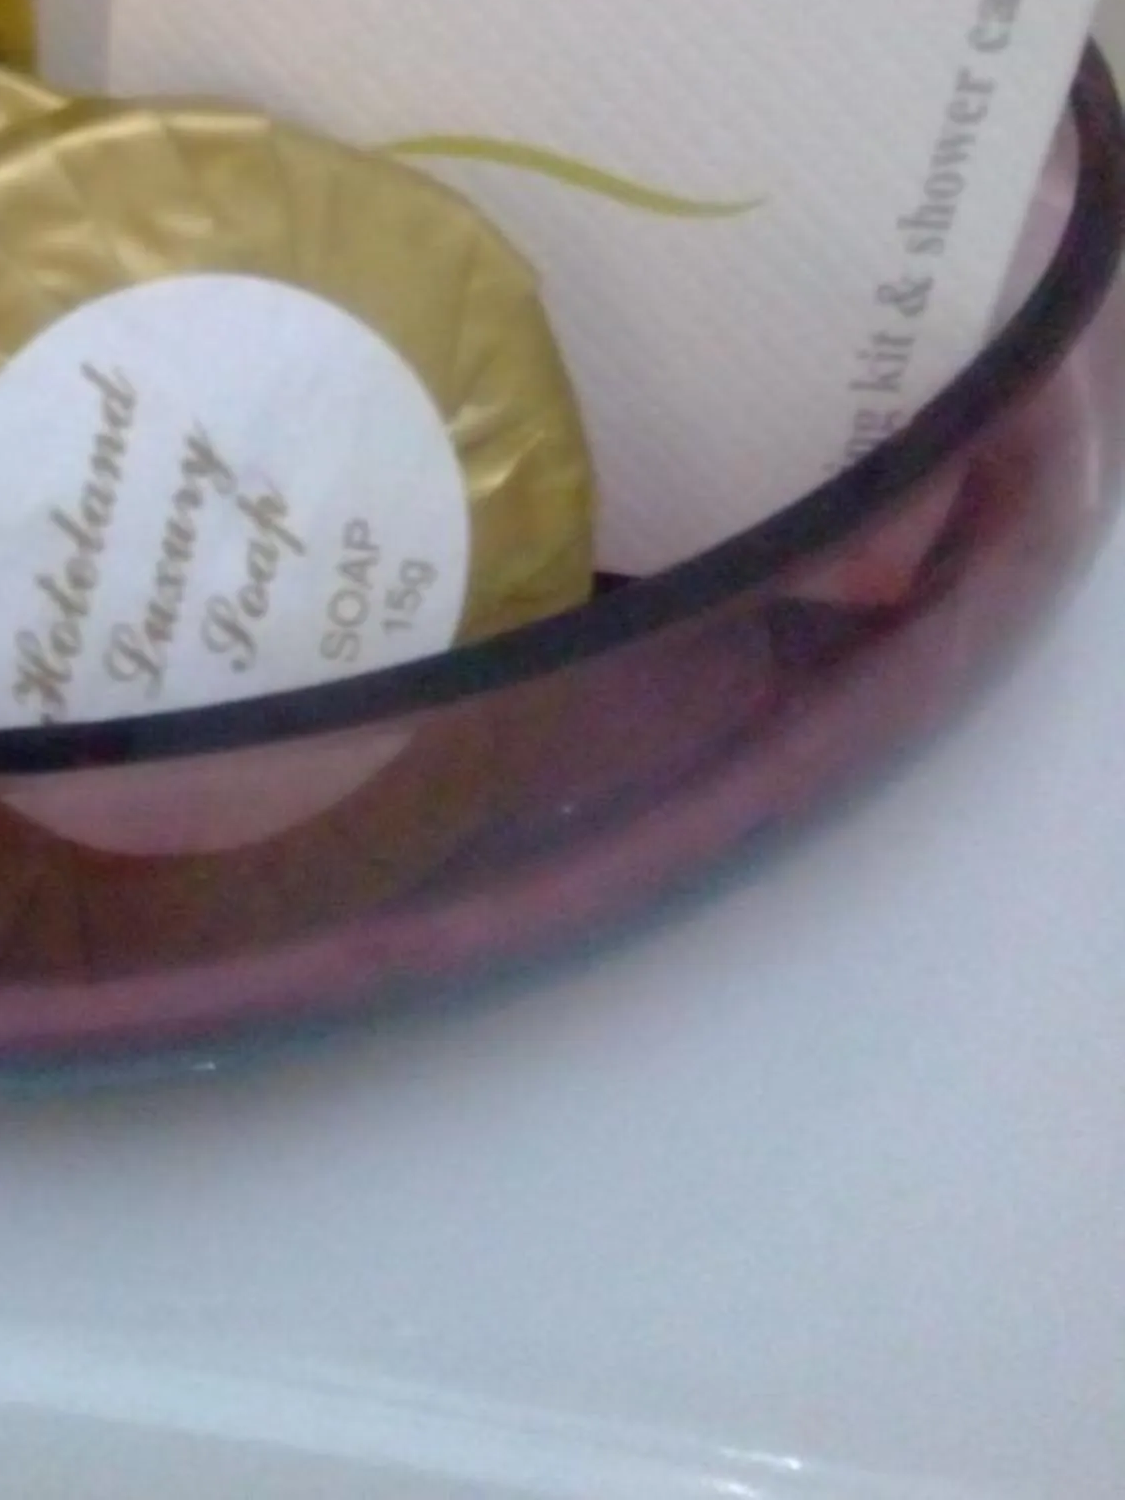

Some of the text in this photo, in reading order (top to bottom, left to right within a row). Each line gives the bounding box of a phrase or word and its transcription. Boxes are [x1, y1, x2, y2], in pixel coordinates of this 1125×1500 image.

[896, 67, 998, 257] shower
[847, 330, 916, 393] kit
[876, 274, 934, 317] &
[103, 414, 238, 699] Luxury
[200, 470, 308, 676] Soap
[319, 516, 382, 665] SOAP
[380, 556, 441, 637] 15g
